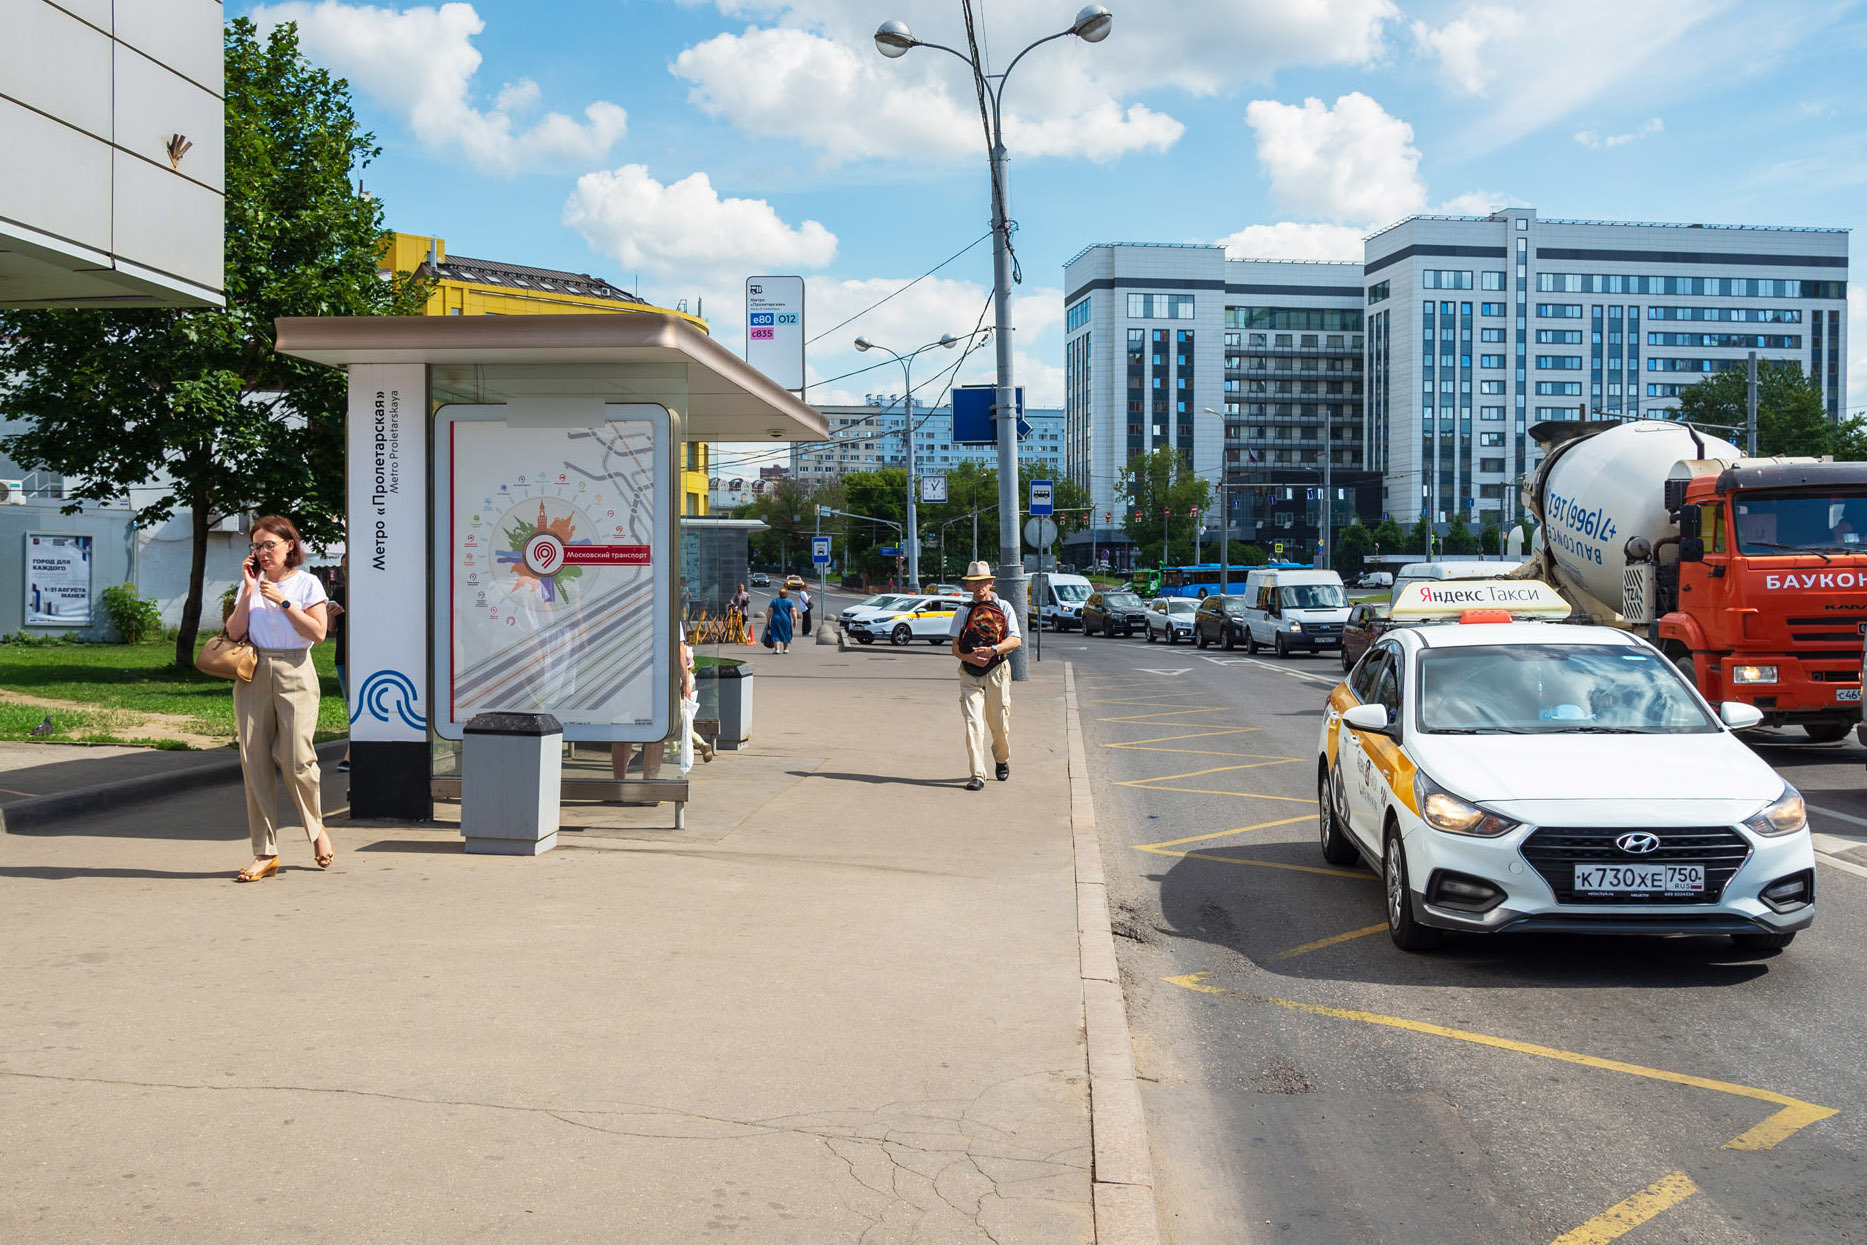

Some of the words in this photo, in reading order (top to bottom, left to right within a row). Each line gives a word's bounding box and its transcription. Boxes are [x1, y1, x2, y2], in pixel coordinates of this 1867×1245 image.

[388, 390, 400, 460] Proletarskaya
[372, 391, 388, 516] «Пролетарская»
[389, 461, 399, 494] Metro
[372, 520, 388, 571] Метро
[1420, 586, 1484, 604] Яндекс
[1486, 586, 1539, 601] Такси
[1667, 867, 1699, 882] 750
